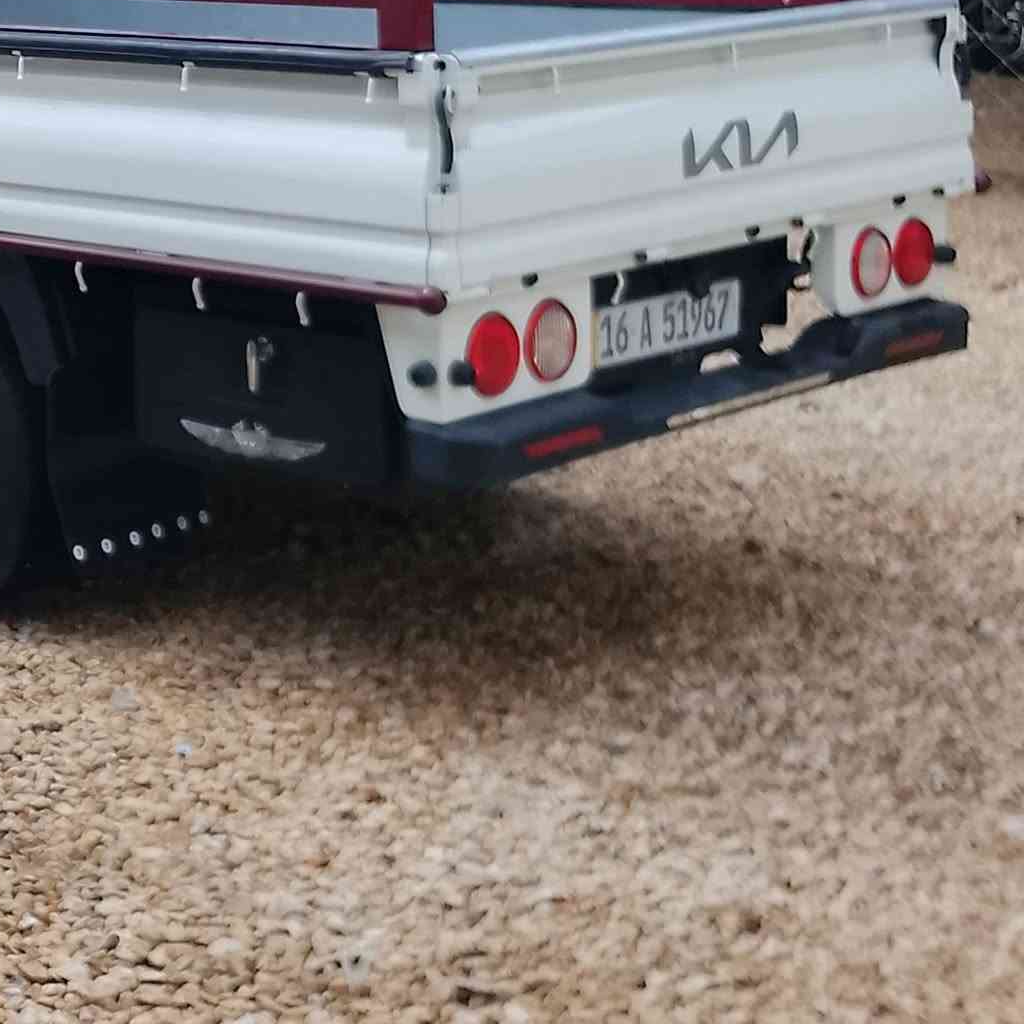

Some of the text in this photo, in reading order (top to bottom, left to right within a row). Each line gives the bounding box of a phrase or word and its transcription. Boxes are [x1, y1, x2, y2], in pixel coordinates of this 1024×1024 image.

[681, 109, 799, 178] KIA
[600, 290, 729, 358] 16 A 51967
